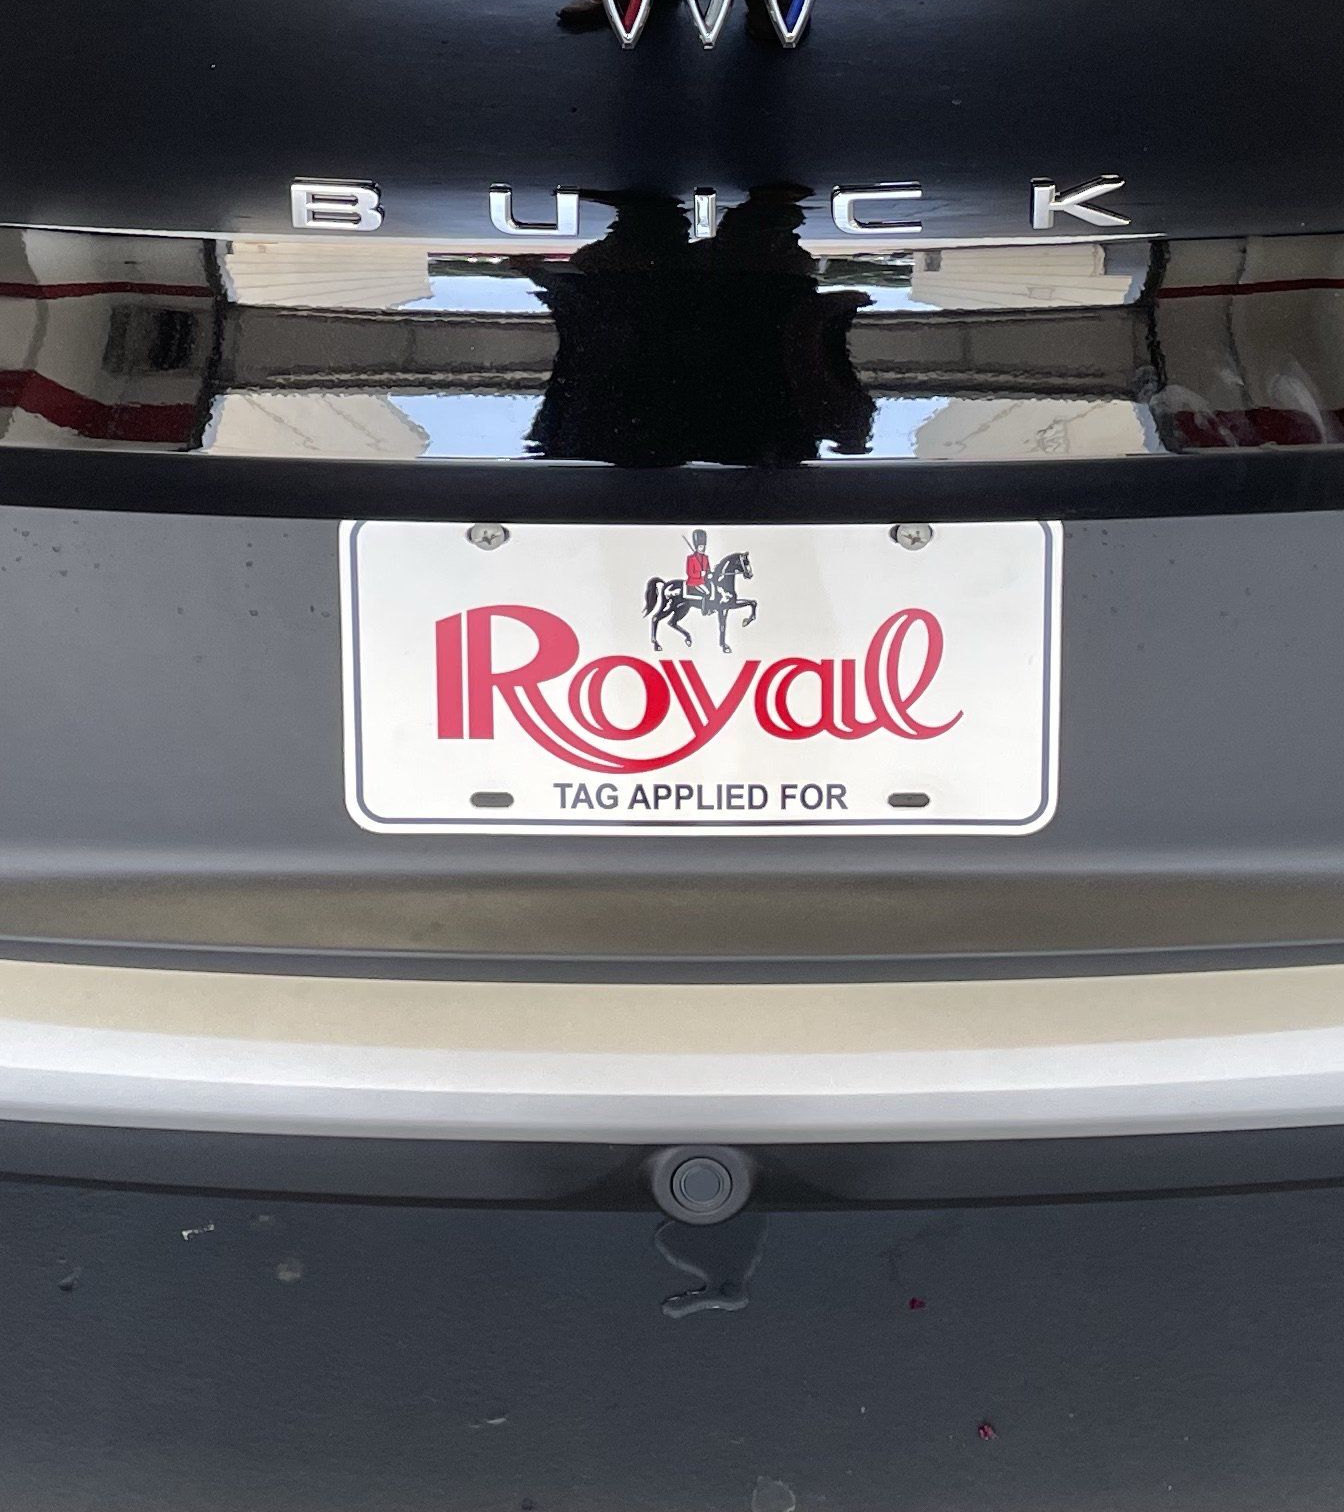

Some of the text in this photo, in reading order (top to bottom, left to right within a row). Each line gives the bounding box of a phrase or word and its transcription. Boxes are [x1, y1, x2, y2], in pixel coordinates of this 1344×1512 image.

[289, 174, 1133, 238] BUICK
[435, 604, 965, 774] Royal
[553, 782, 849, 811] TAG APPLIED FOR
